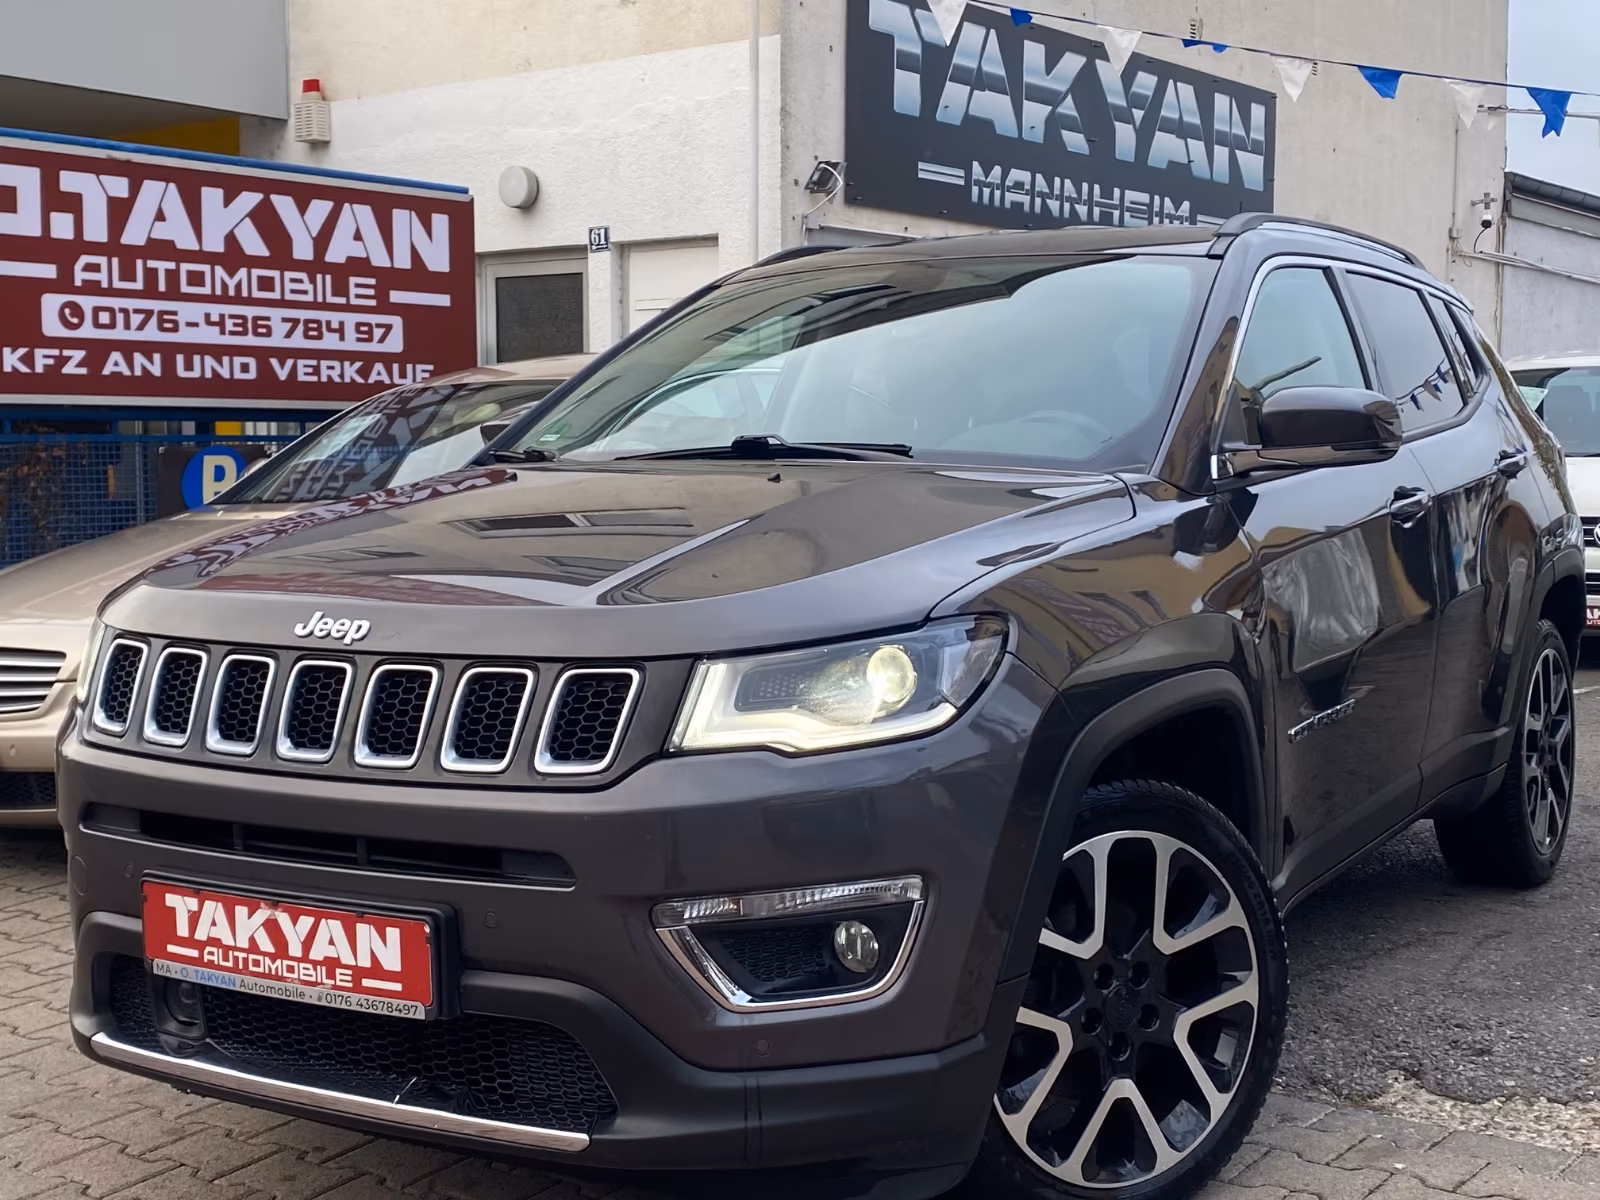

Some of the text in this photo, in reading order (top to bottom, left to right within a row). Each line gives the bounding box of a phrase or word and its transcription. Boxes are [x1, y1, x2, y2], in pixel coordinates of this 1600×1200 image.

[869, 0, 1266, 191] TAKYAN
[971, 161, 1191, 226] MANNHEIM
[591, 229, 607, 245] 61
[74, 254, 377, 306] AUTOMOBILE
[281, 317, 345, 341] 784
[354, 322, 393, 344] 97
[2, 347, 434, 384] KFZ AN UND VERKAUF
[202, 455, 237, 504] P
[294, 611, 371, 645] Jeep
[165, 893, 401, 972] TAKYAN
[156, 963, 172, 976] MA
[194, 970, 236, 988] TAKYAN
[240, 979, 306, 1000] Automobile
[325, 993, 352, 1008] 0176
[356, 998, 418, 1016] 43678497
[203, 946, 353, 988] AUTOMOBILE
